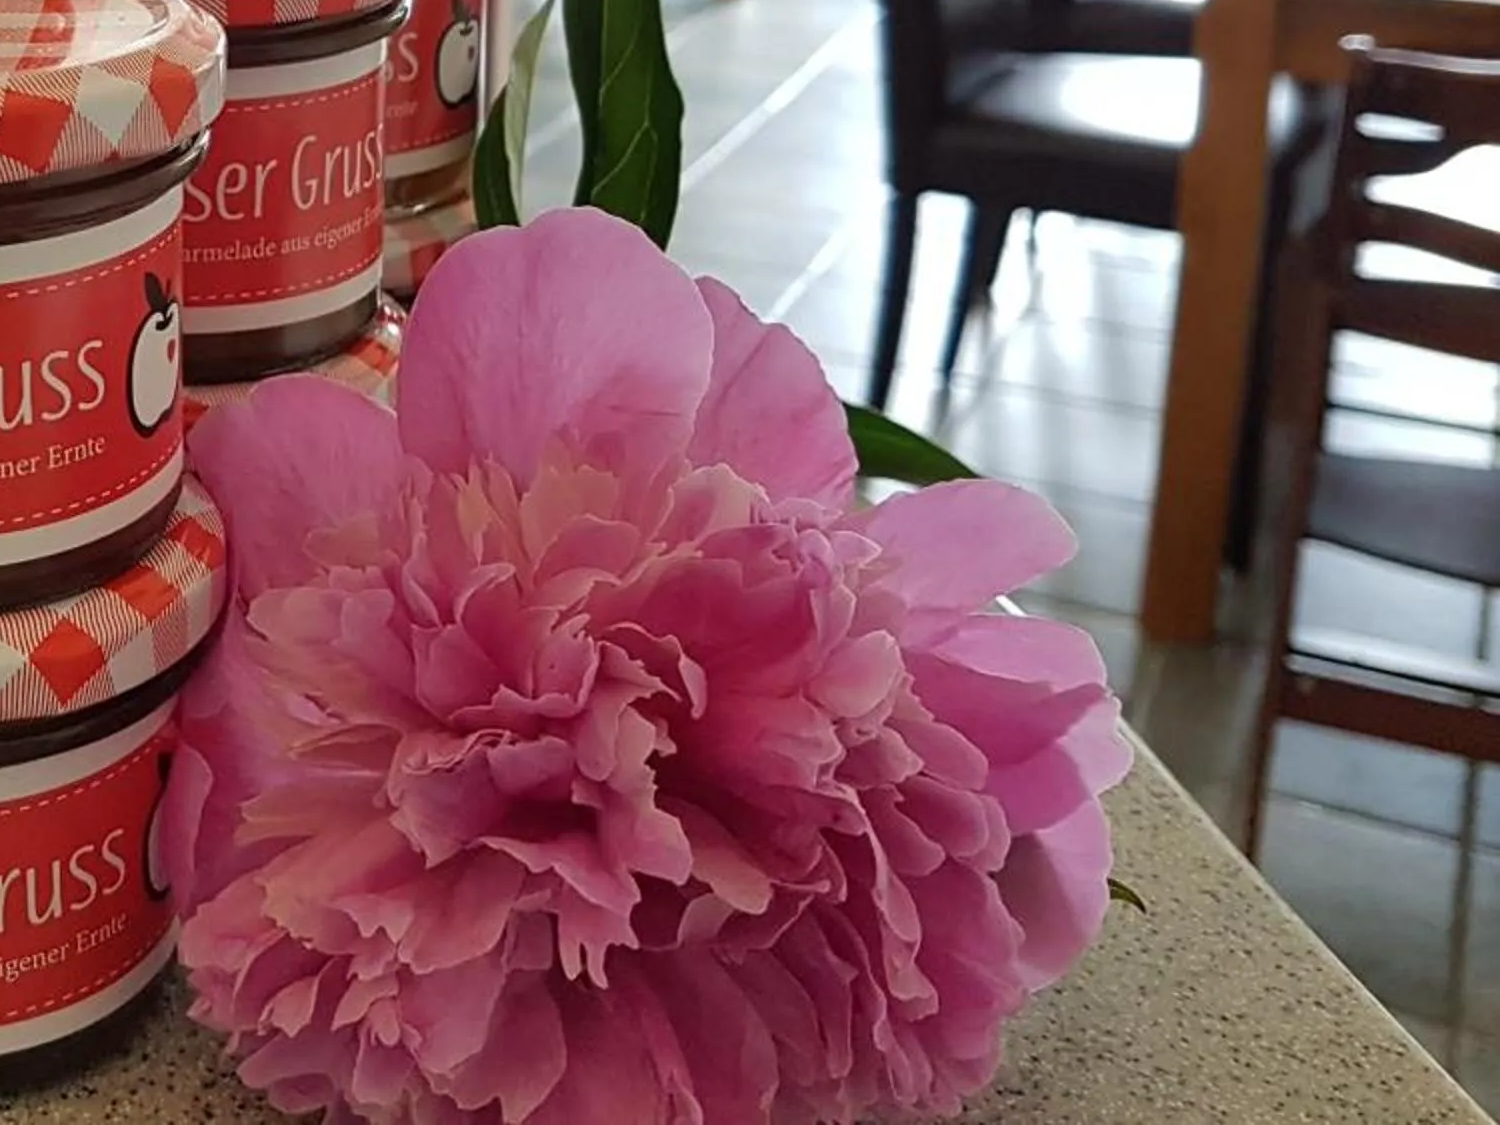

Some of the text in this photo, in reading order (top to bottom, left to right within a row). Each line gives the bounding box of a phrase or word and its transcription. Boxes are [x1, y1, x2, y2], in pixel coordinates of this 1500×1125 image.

[291, 120, 384, 211] Gruss
[281, 235, 311, 257] aus
[314, 216, 364, 251] eigener
[47, 435, 107, 470] Ernte
[74, 911, 128, 955] Ernte
